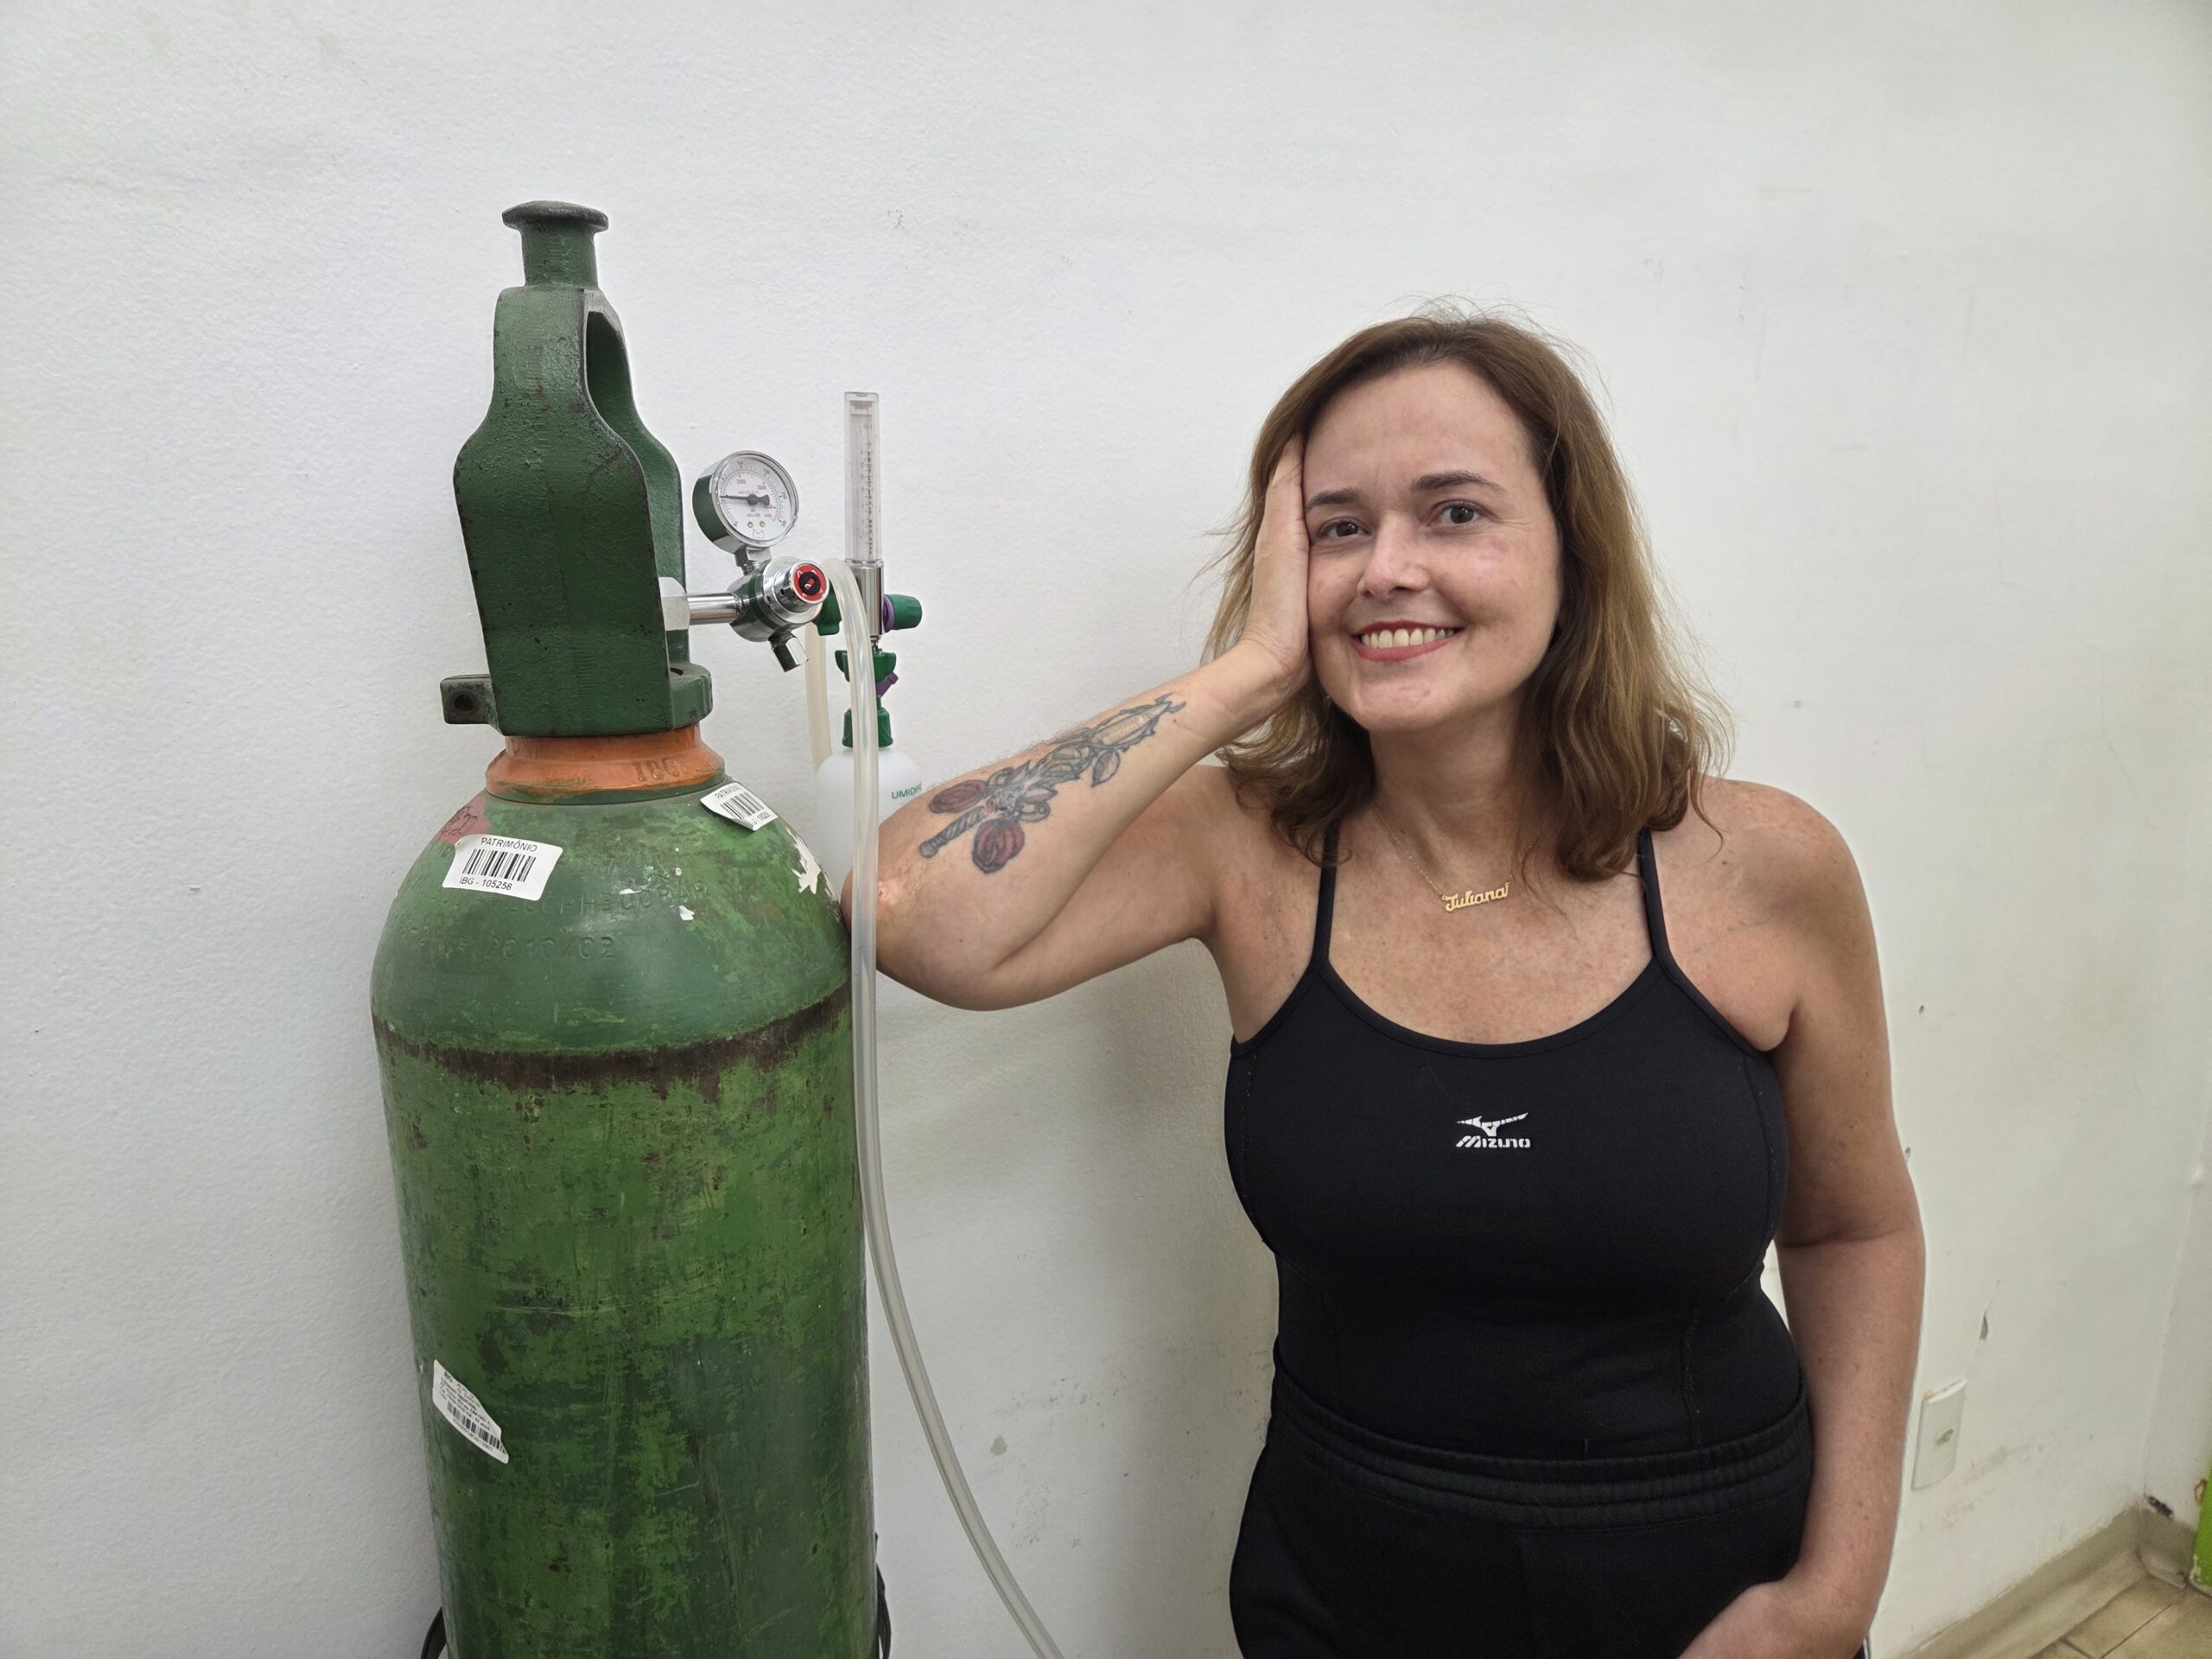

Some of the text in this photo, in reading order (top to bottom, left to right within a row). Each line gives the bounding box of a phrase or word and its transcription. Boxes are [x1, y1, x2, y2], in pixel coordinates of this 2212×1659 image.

[481, 837, 537, 853] PATRIMÔNIO
[459, 876, 474, 886] IBG
[482, 879, 513, 891] 105258
[1445, 882, 1510, 912] Juliana
[1456, 1135, 1531, 1147] MIZUNO
